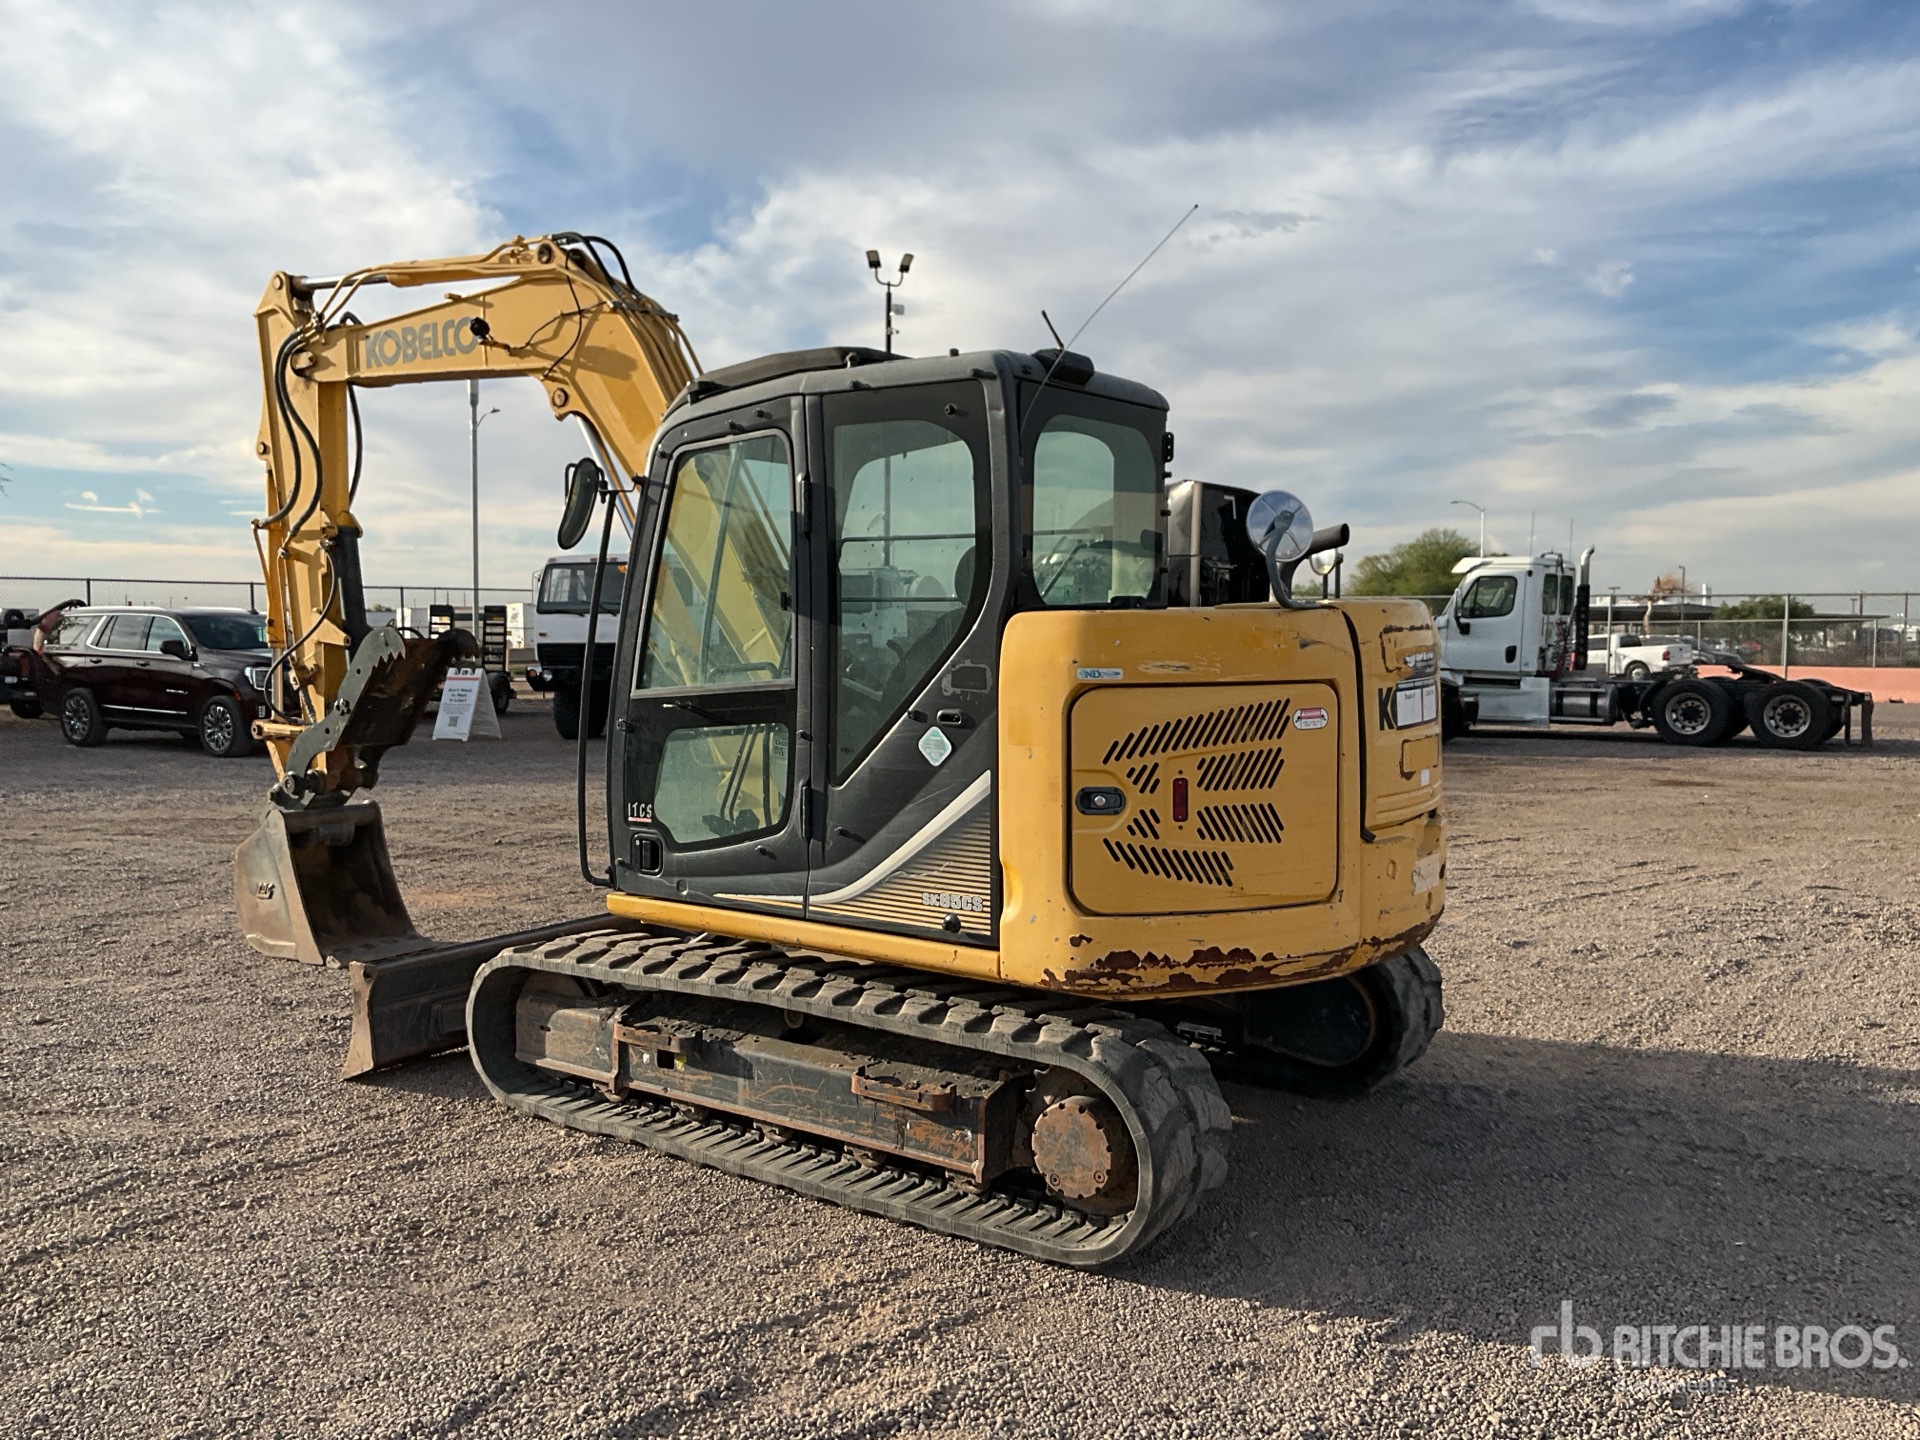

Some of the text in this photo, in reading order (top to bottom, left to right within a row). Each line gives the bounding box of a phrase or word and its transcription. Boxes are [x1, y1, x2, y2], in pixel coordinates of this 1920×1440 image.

[365, 317, 478, 368] KOBELCO
[628, 801, 652, 818] ITCS
[922, 892, 983, 912] SK85CS
